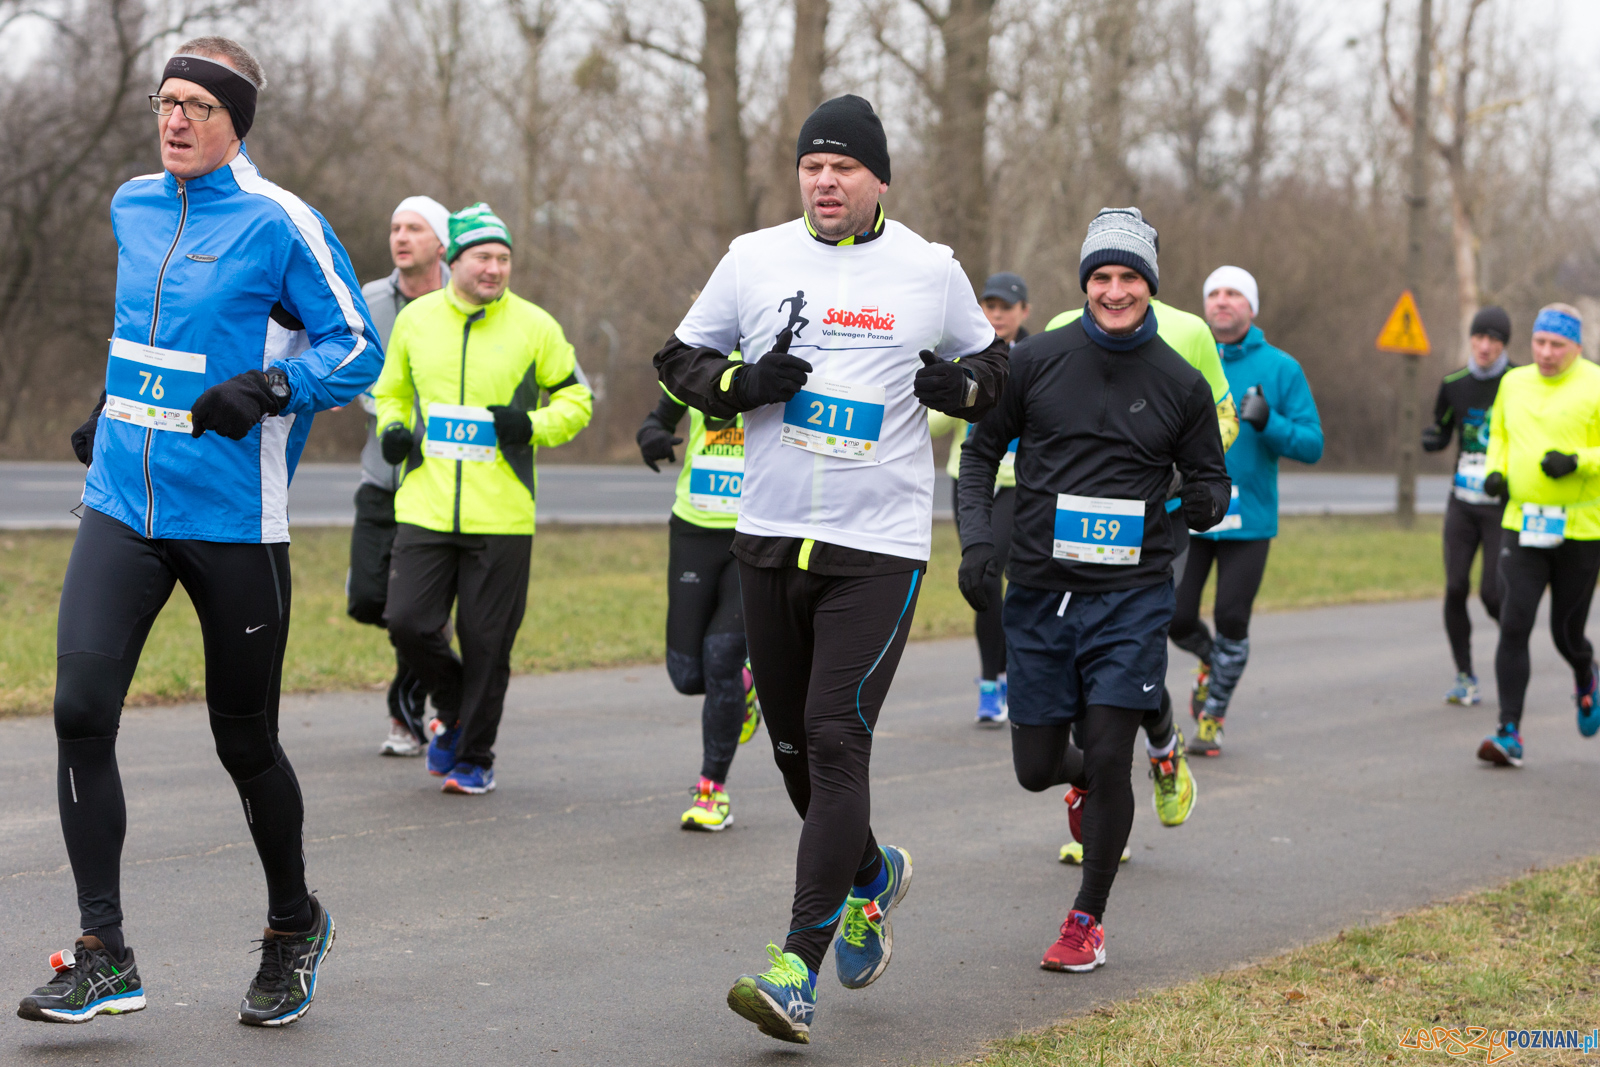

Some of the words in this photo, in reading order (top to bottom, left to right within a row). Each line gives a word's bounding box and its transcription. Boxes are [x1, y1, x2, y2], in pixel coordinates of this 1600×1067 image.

[822, 329, 866, 339] Volkswagen
[867, 332, 894, 341] Poznań
[139, 370, 165, 400] 76
[807, 400, 854, 431] 211
[445, 421, 478, 441] 169
[708, 473, 742, 495] 170
[1080, 517, 1121, 541] 159
